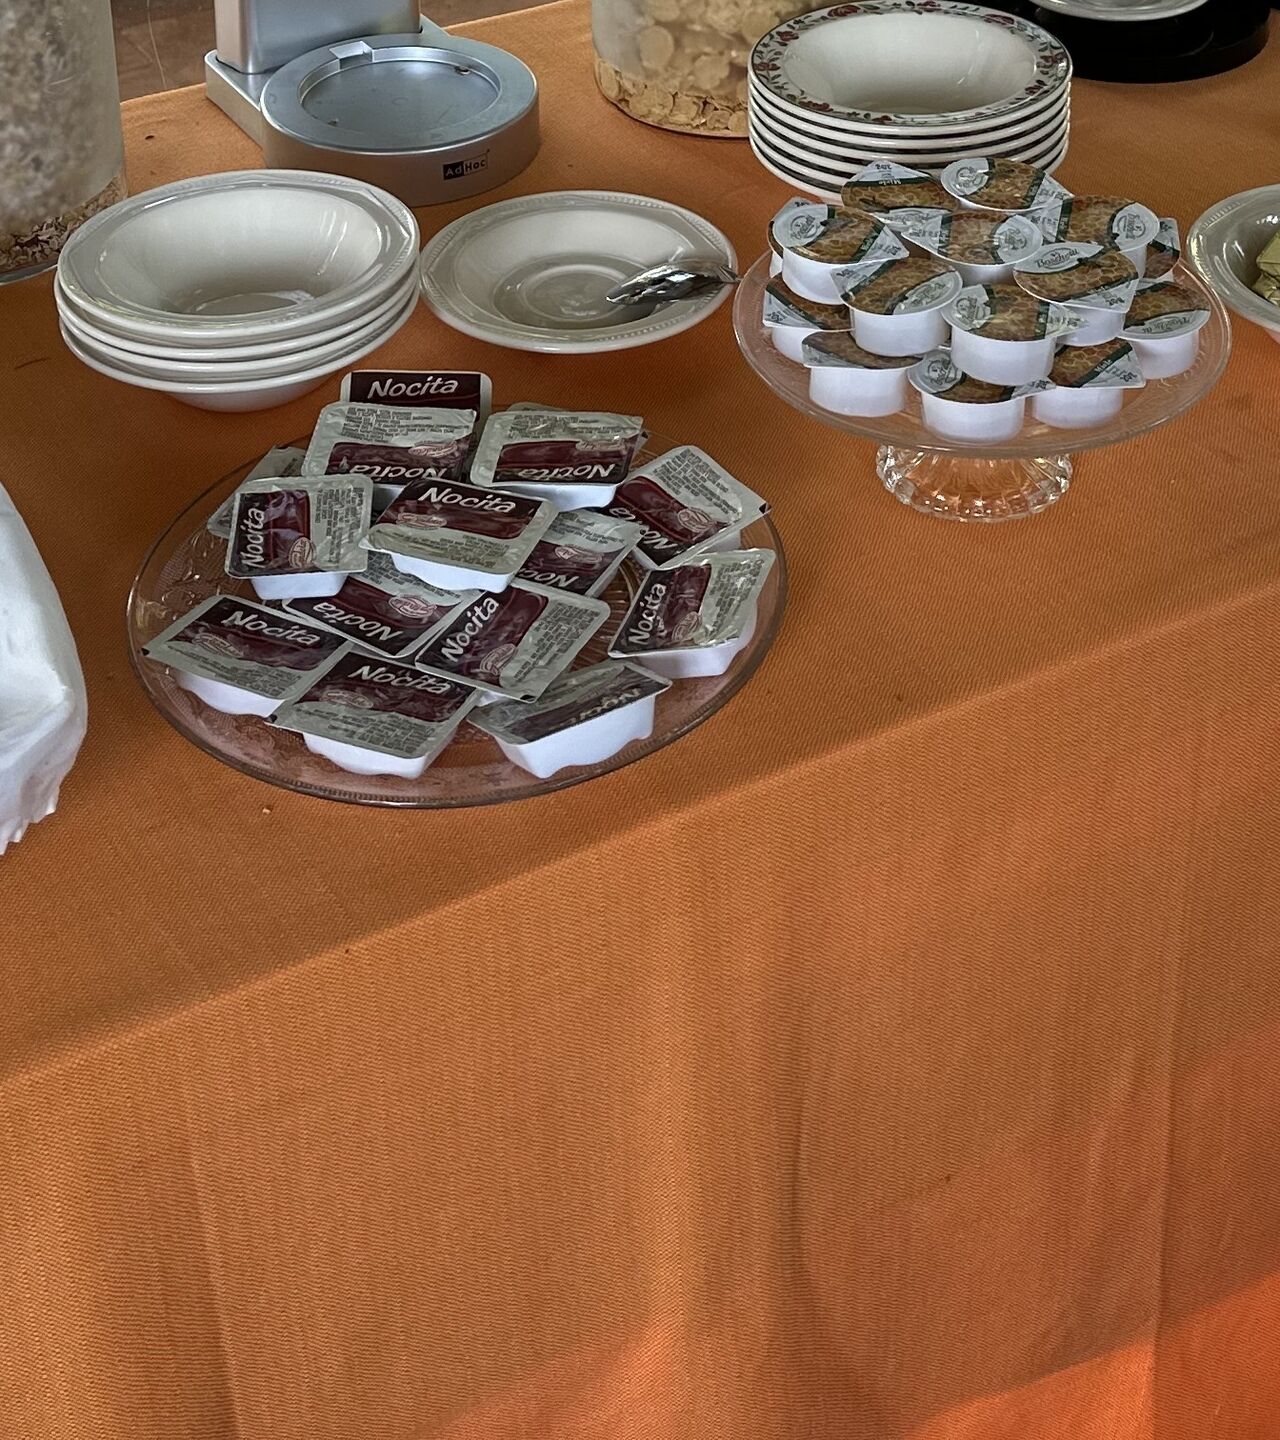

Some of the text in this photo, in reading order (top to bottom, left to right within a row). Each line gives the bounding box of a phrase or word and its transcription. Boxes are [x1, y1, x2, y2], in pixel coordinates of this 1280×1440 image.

[445, 159, 487, 177] AdHoc
[367, 375, 460, 400] Nocita
[348, 463, 448, 482] Nocita
[517, 463, 616, 482] Nocita
[417, 486, 517, 514] Nocita
[238, 507, 267, 570] Nocita
[220, 609, 322, 647] Nocita
[312, 600, 405, 643] Nocita
[439, 596, 500, 663] Nocita
[628, 582, 668, 646] Nocita
[347, 664, 453, 695] Nocita
